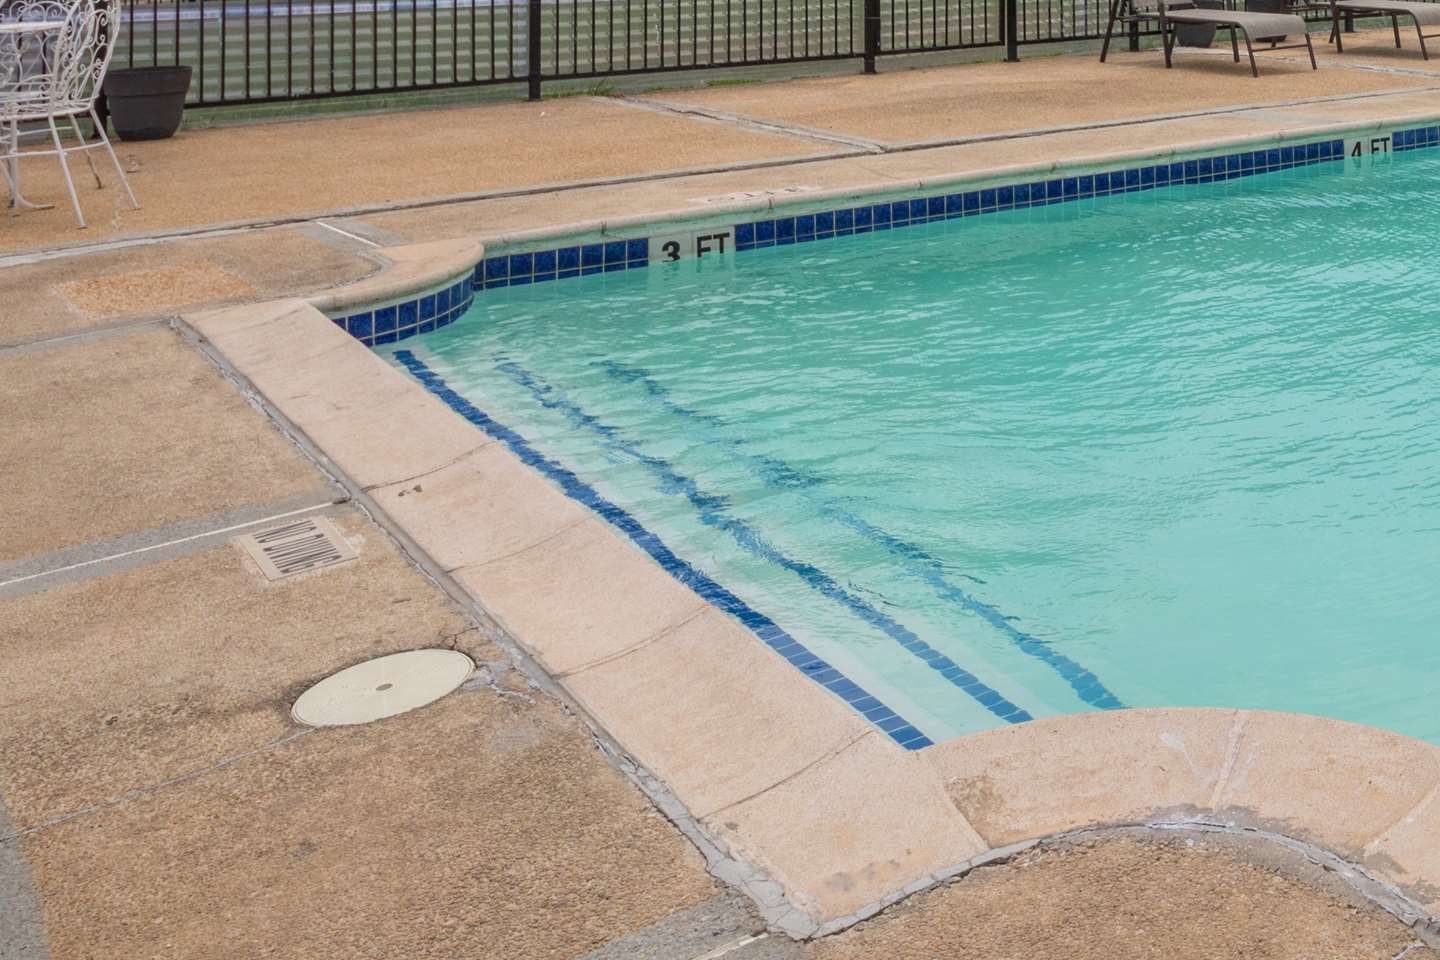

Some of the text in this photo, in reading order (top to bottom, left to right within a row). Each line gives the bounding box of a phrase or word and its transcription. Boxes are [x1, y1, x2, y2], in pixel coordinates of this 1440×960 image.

[1351, 136, 1390, 157] 4 FT
[662, 232, 730, 263] 3 FT
[253, 519, 343, 575] NO DIVING
